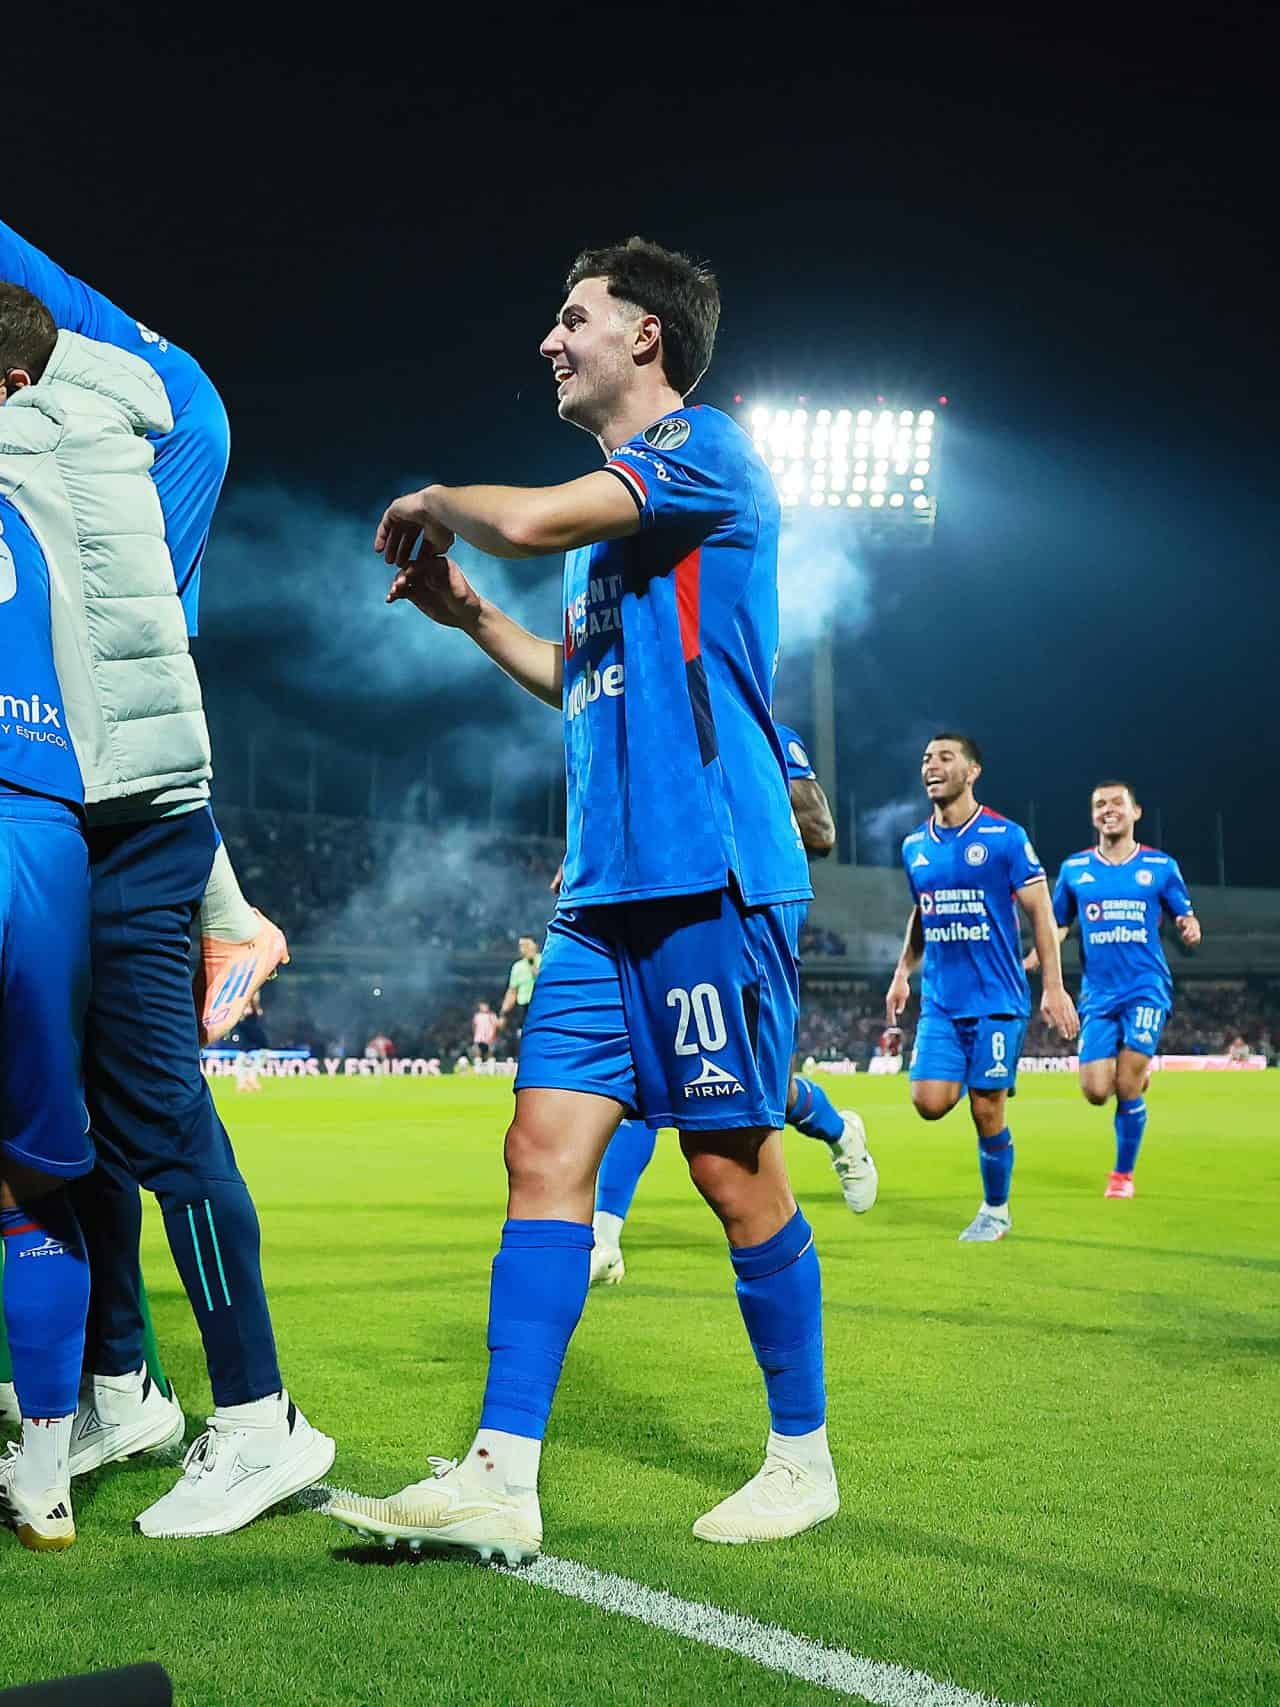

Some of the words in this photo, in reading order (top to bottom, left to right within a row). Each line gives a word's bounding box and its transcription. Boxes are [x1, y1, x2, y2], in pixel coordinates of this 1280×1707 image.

[1, 724, 11, 735] Y
[924, 922, 991, 942] novibet
[1090, 926, 1148, 944] novibet
[666, 983, 727, 1056] 20
[324, 1059, 340, 1076] Y
[19, 1247, 65, 1258] PIRM
